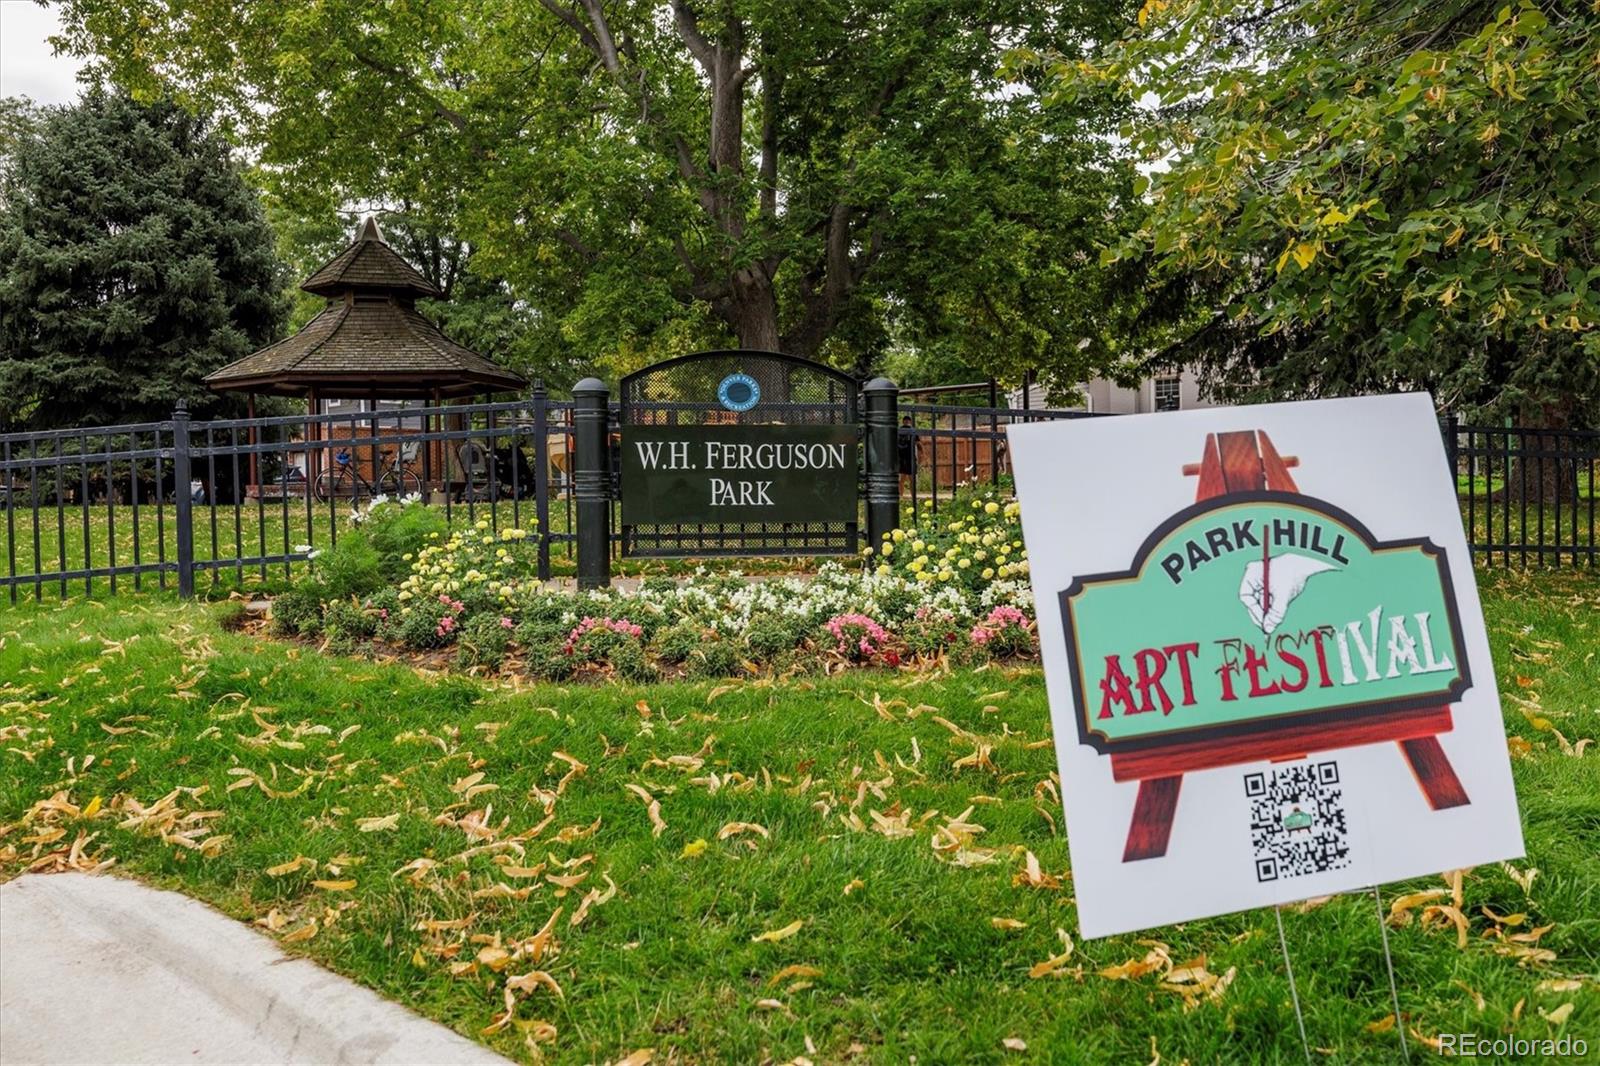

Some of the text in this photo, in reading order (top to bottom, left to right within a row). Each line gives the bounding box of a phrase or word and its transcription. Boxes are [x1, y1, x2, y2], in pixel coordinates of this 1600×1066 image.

[635, 442, 846, 469] W.H. FERGUSON
[709, 478, 775, 506] PARK
[1161, 519, 1350, 585] PARK HILL
[1097, 605, 1455, 719] ART FESTIVAL
